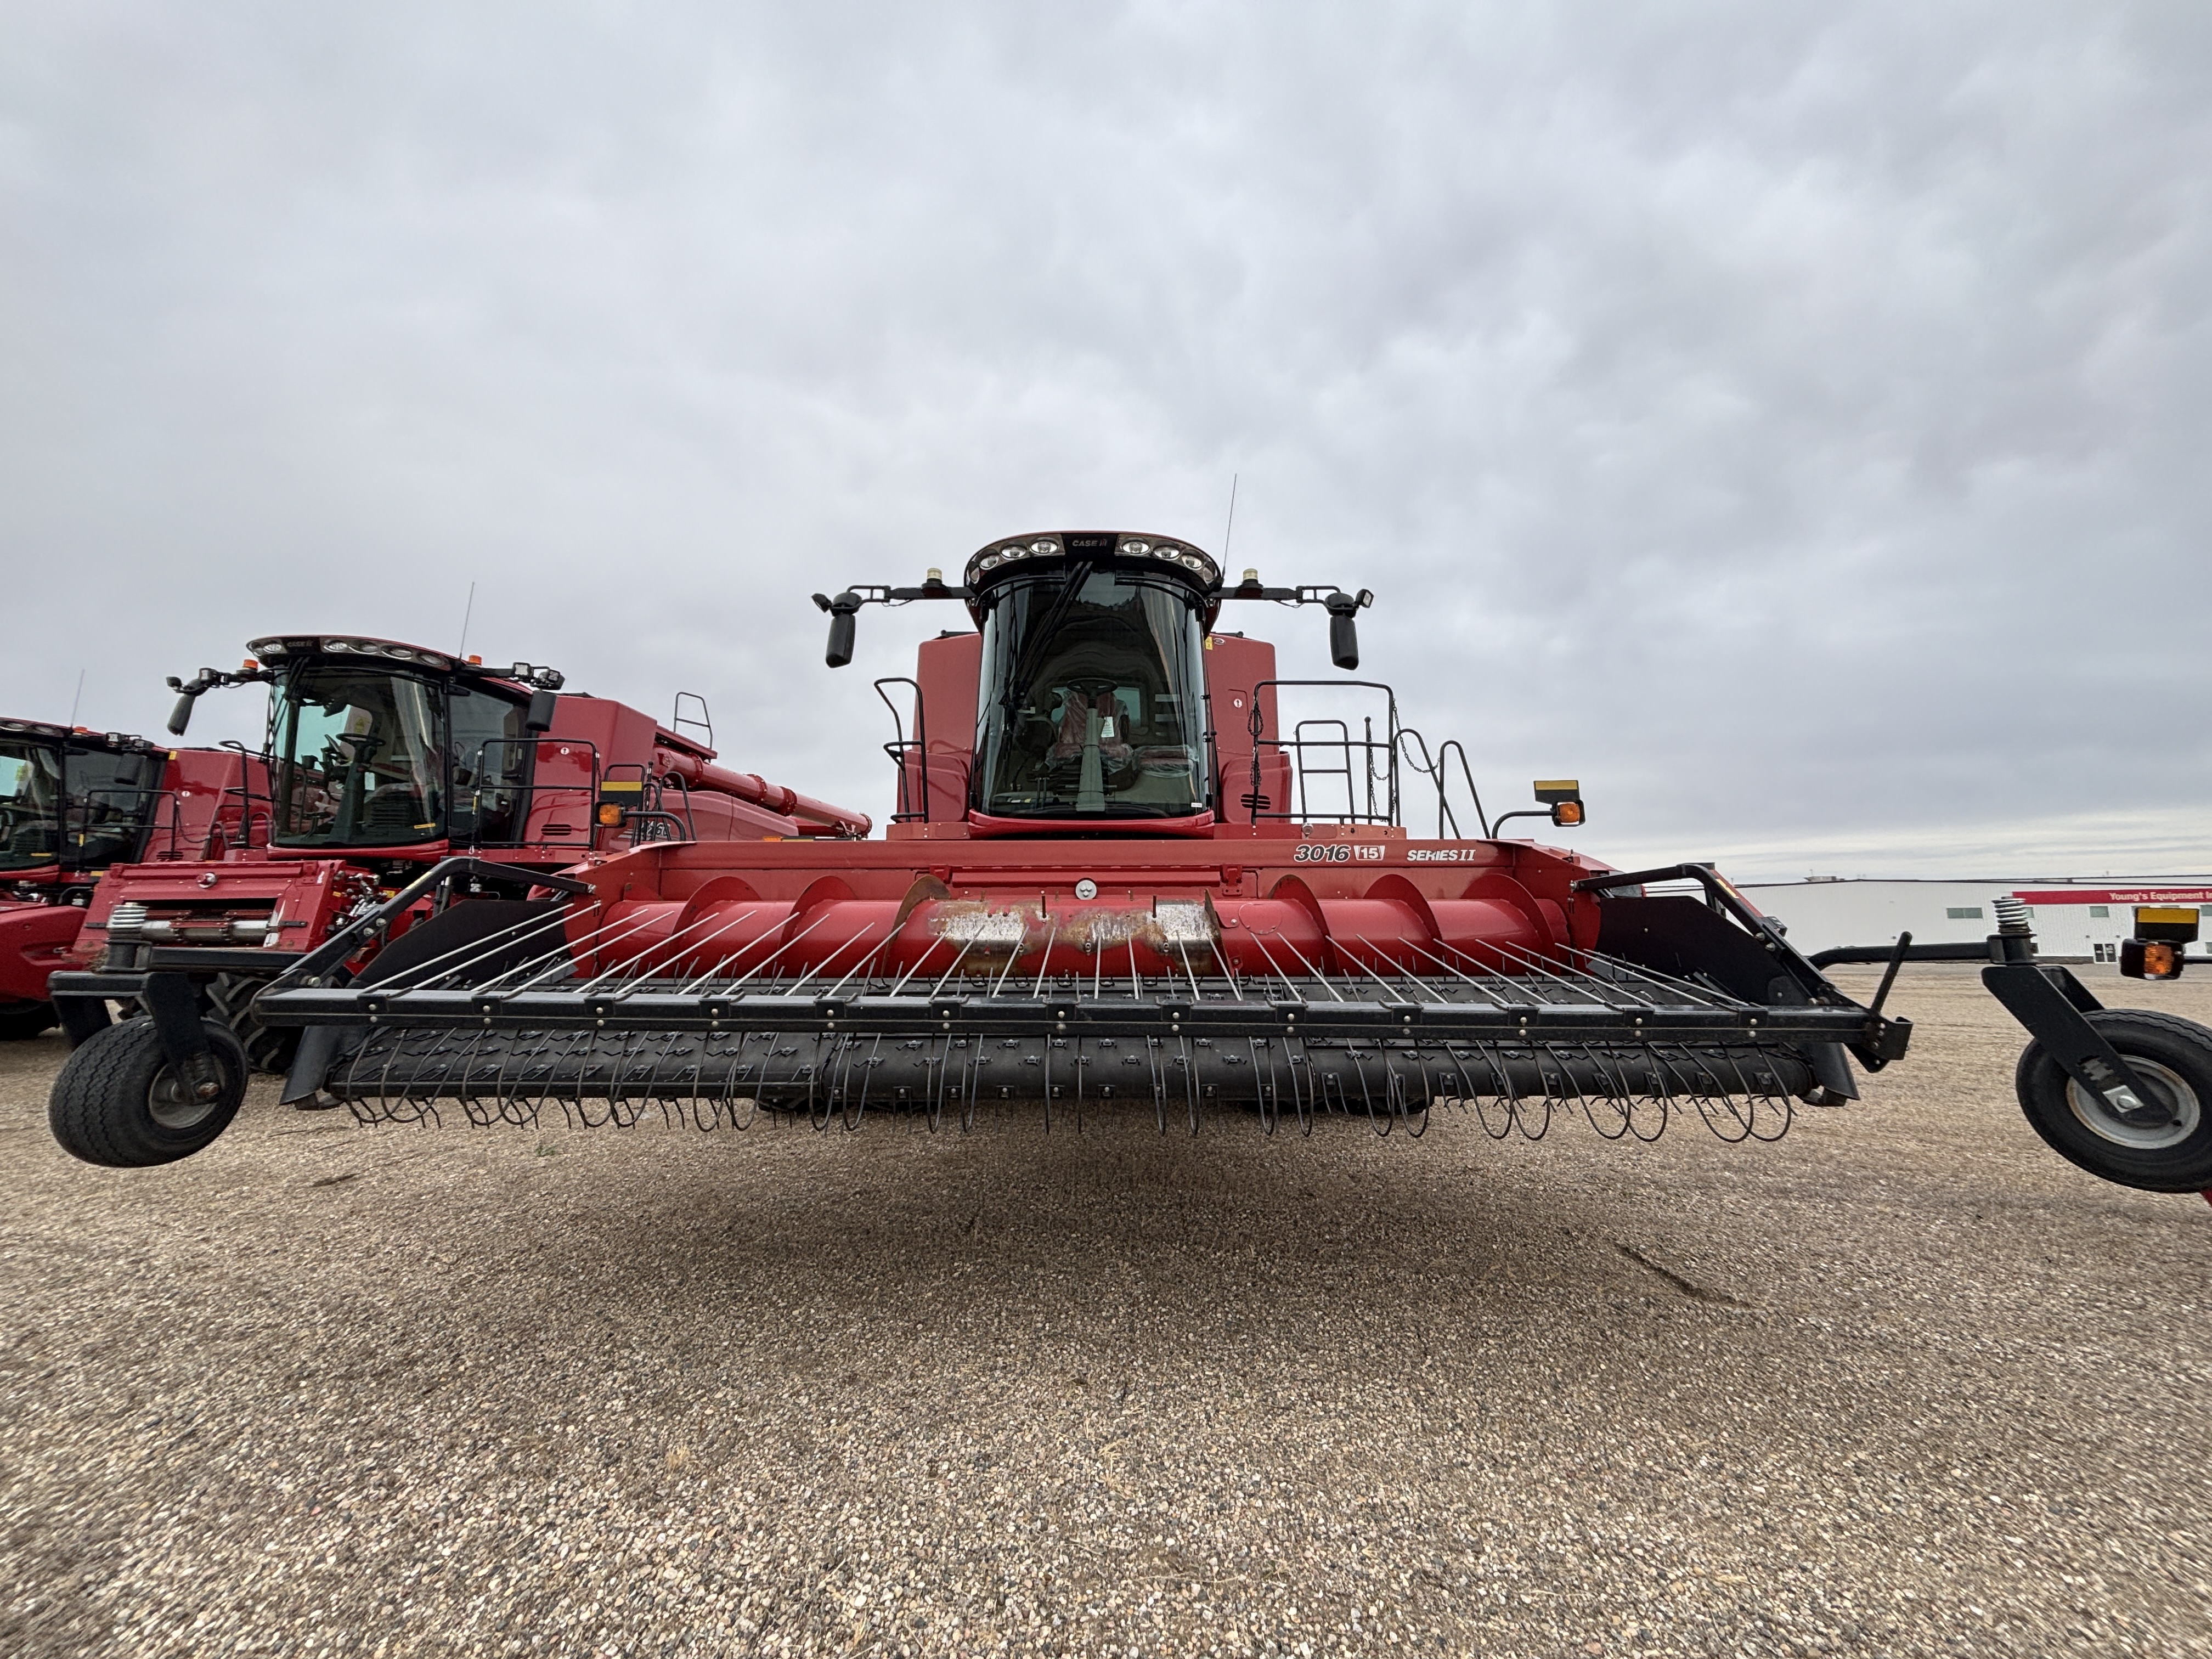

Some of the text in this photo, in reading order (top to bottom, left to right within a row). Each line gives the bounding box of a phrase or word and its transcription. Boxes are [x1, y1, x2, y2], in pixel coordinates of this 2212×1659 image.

[1294, 844, 1476, 862] 3016 15 SERIES II
[2109, 892, 2148, 901] Young's
[2150, 891, 2204, 901] Equipment
